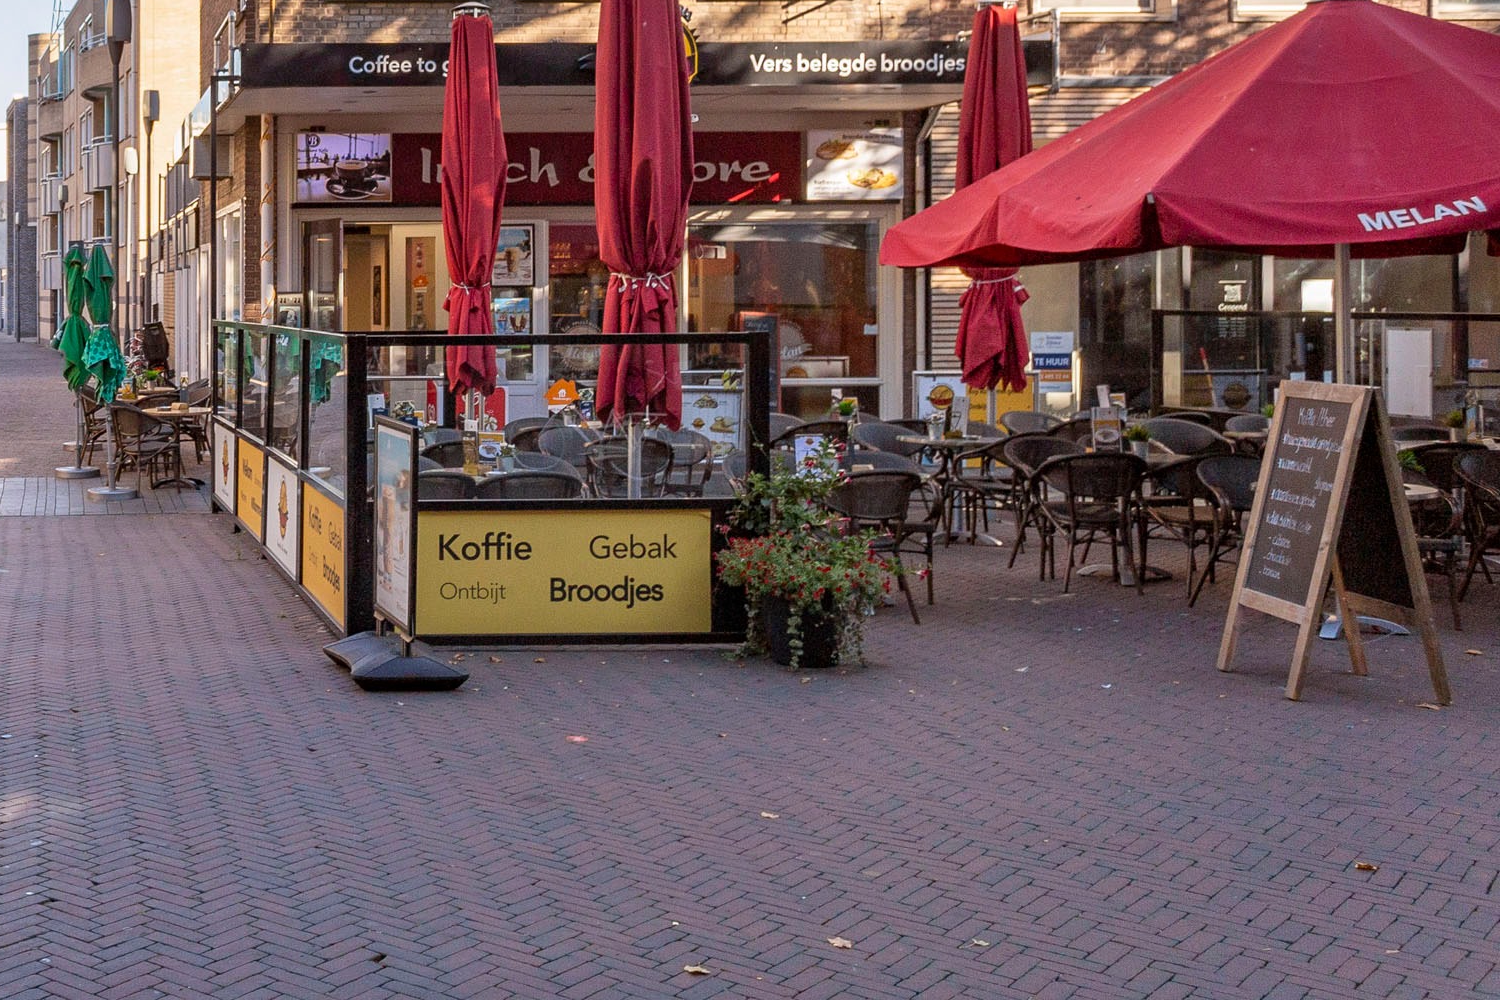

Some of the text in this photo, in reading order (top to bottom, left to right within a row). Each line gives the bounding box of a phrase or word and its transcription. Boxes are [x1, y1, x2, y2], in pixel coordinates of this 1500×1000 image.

[349, 55, 412, 73] Coffee
[416, 57, 437, 73] to
[749, 53, 966, 77] Vers belegde broodjes
[1357, 196, 1487, 232] MELAN
[1034, 357, 1069, 366] TE HUUR
[438, 532, 677, 560] Koffie Gebak
[440, 575, 664, 609] Ontbijt Broodjes
